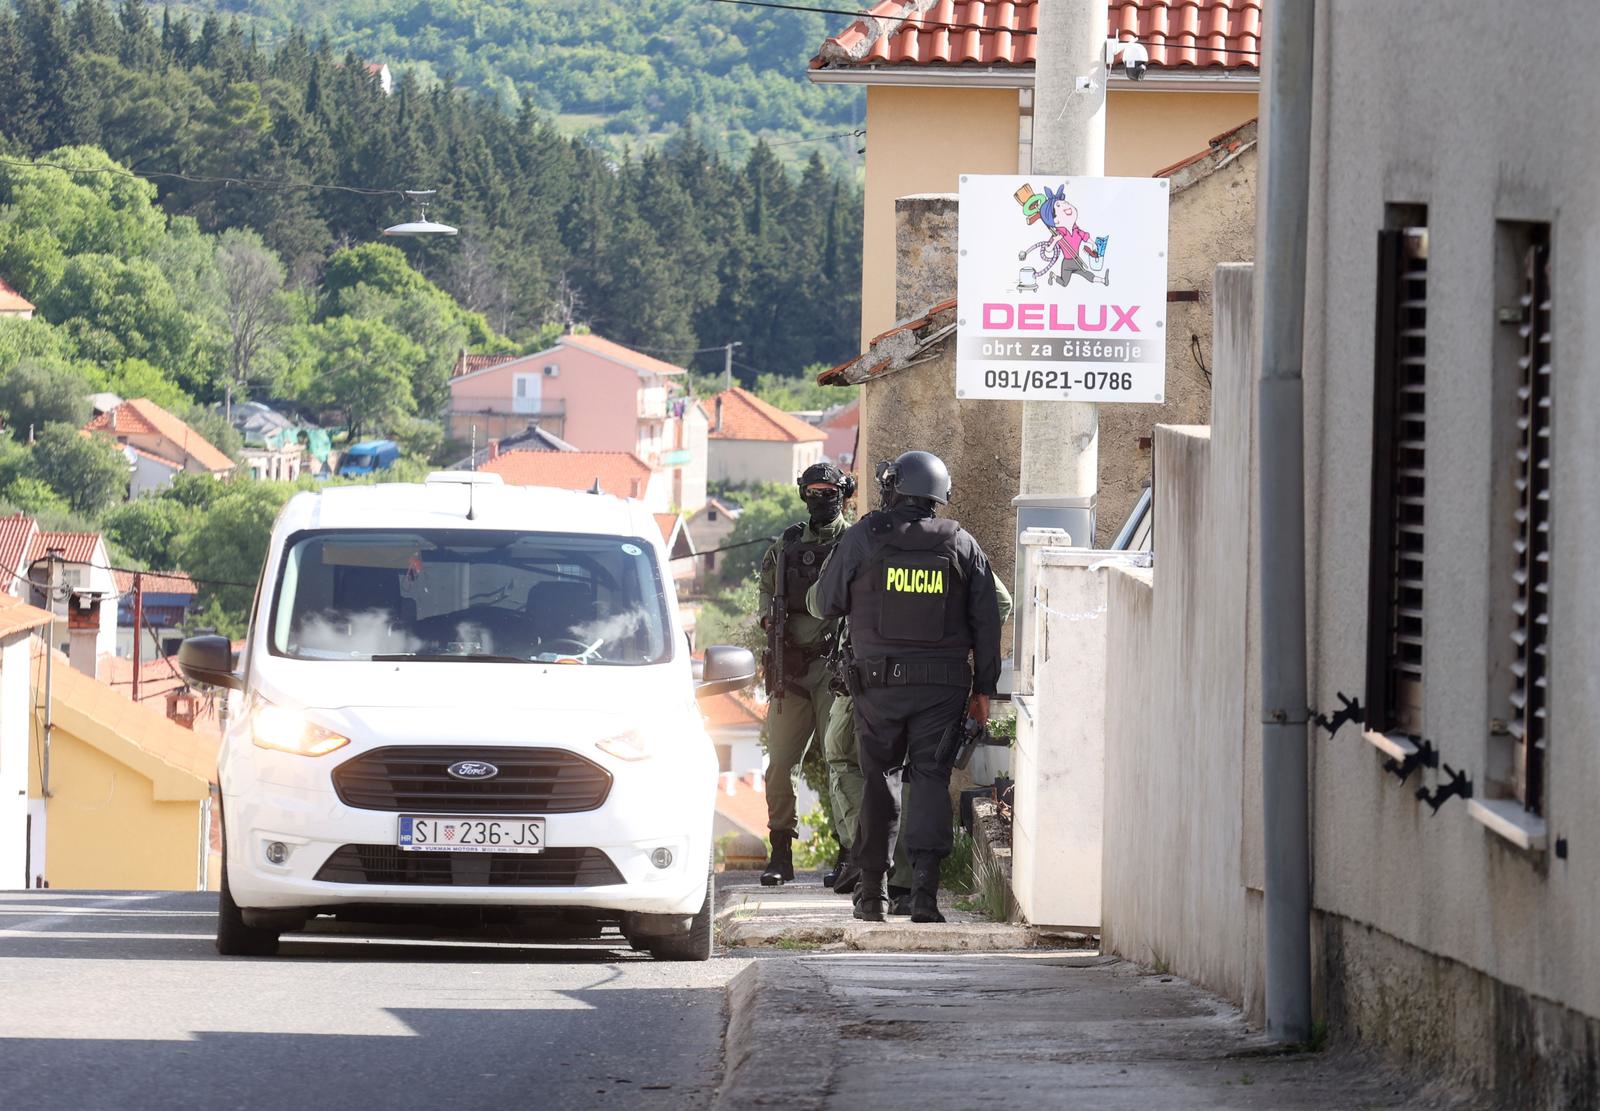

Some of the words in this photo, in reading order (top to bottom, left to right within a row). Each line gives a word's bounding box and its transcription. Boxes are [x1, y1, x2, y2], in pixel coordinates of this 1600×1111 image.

[982, 303, 1141, 332] DELUX
[982, 340, 1022, 357] obrt
[1031, 344, 1052, 357] za
[1063, 340, 1142, 361] čišćenje
[984, 370, 1132, 392] 091/621-0786
[886, 567, 943, 594] POLICIJA
[459, 763, 487, 775] Ford
[460, 822, 540, 845] 236-JS
